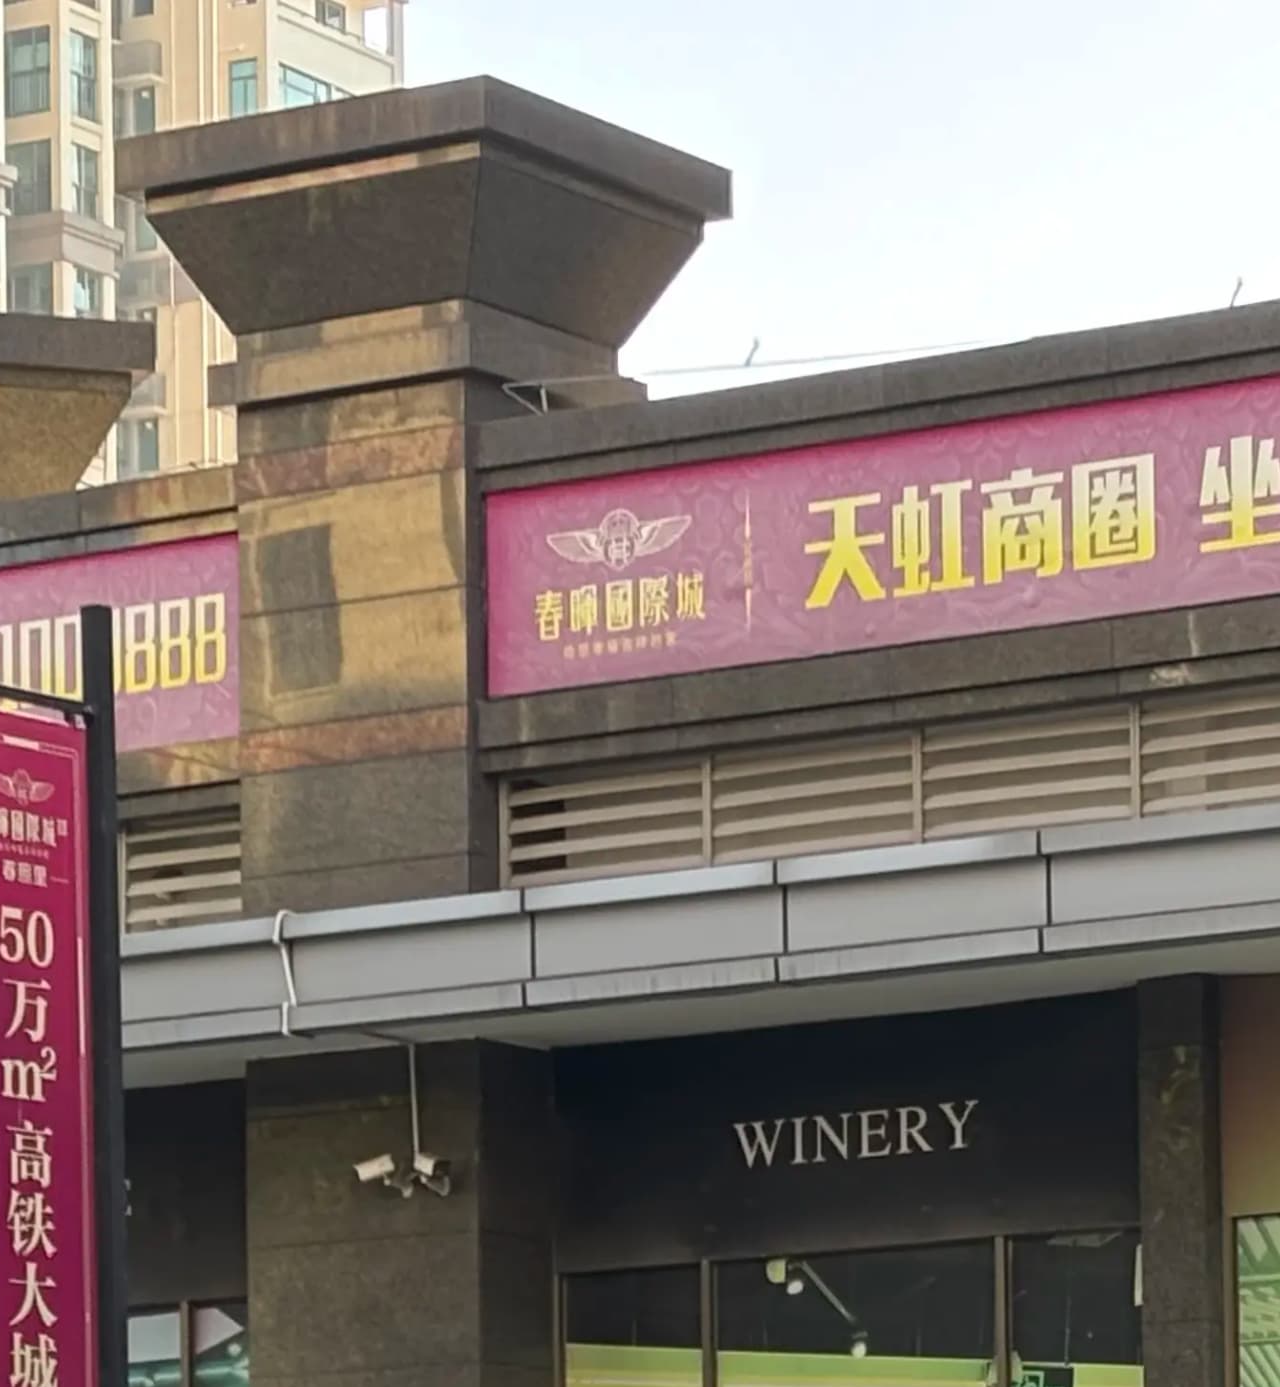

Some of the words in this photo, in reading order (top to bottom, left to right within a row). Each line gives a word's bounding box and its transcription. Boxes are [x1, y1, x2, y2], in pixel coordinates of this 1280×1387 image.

[804, 453, 1157, 610] 天虹商圈
[733, 1099, 979, 1169] WINERY
